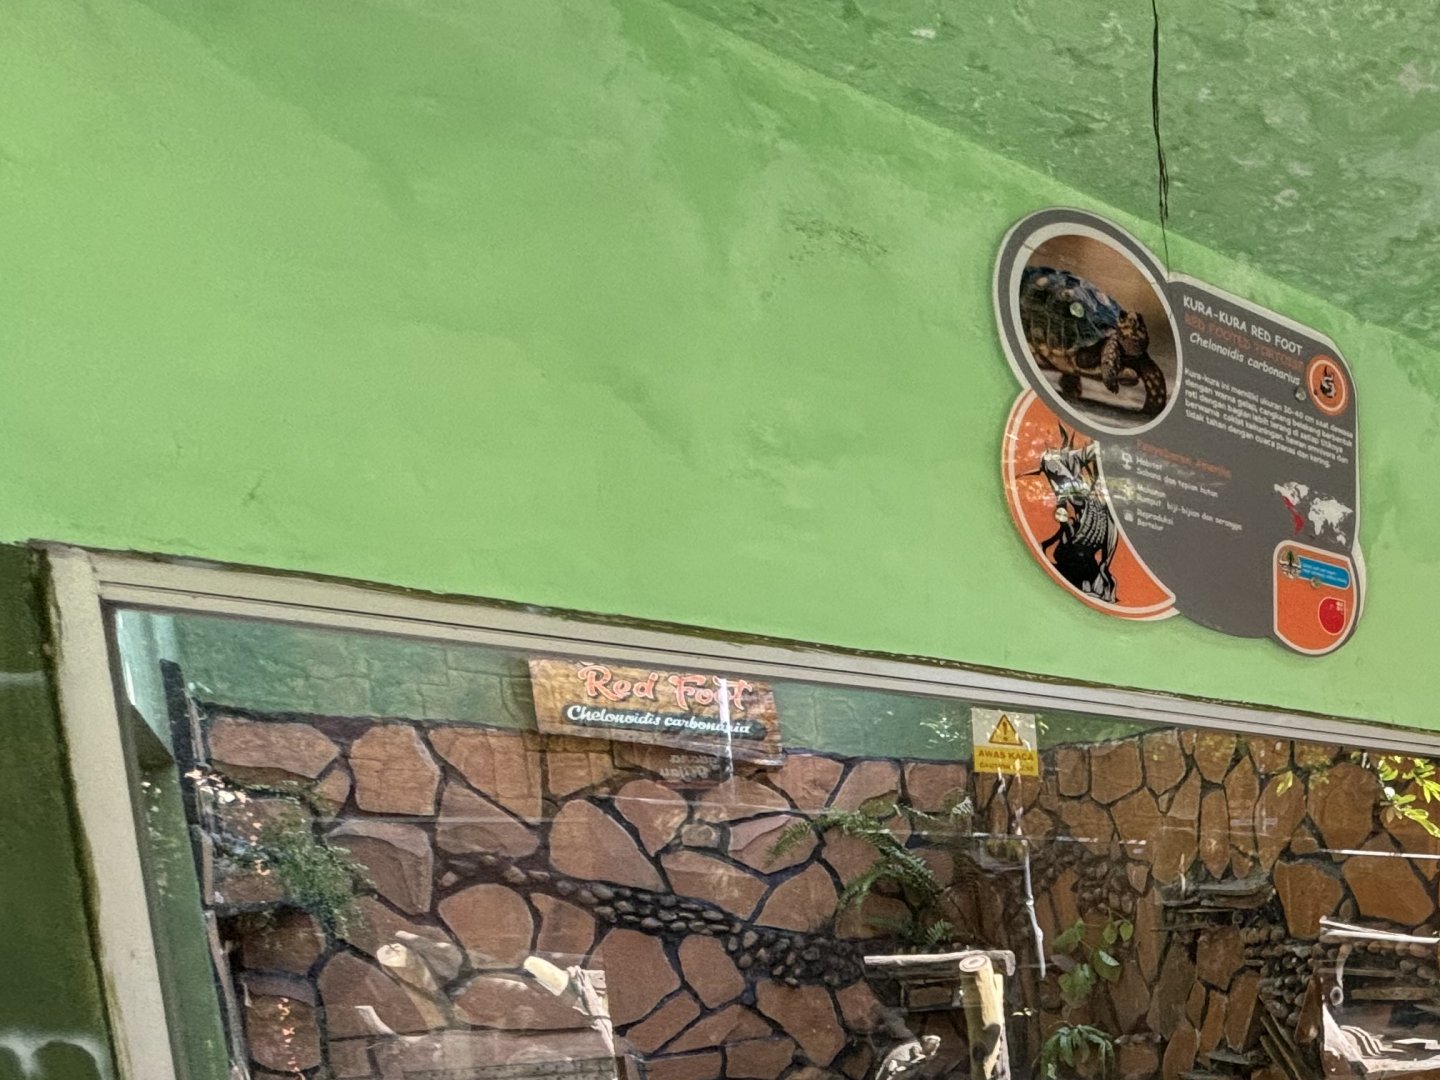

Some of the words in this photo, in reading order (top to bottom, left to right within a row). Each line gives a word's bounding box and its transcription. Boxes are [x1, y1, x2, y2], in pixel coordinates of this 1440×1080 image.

[1183, 295, 1247, 333] KURA-KURA
[1251, 324, 1271, 343] RED
[1274, 335, 1303, 356] FOOT
[1189, 331, 1244, 363] Chelonoidis
[1247, 356, 1301, 386] carbonarius
[577, 664, 659, 702] Red
[667, 674, 753, 712] Foot
[566, 704, 661, 727] Chelonoidis
[664, 715, 752, 735] carbonaria
[978, 749, 1006, 760] AWAS
[1008, 751, 1034, 761] KACA
